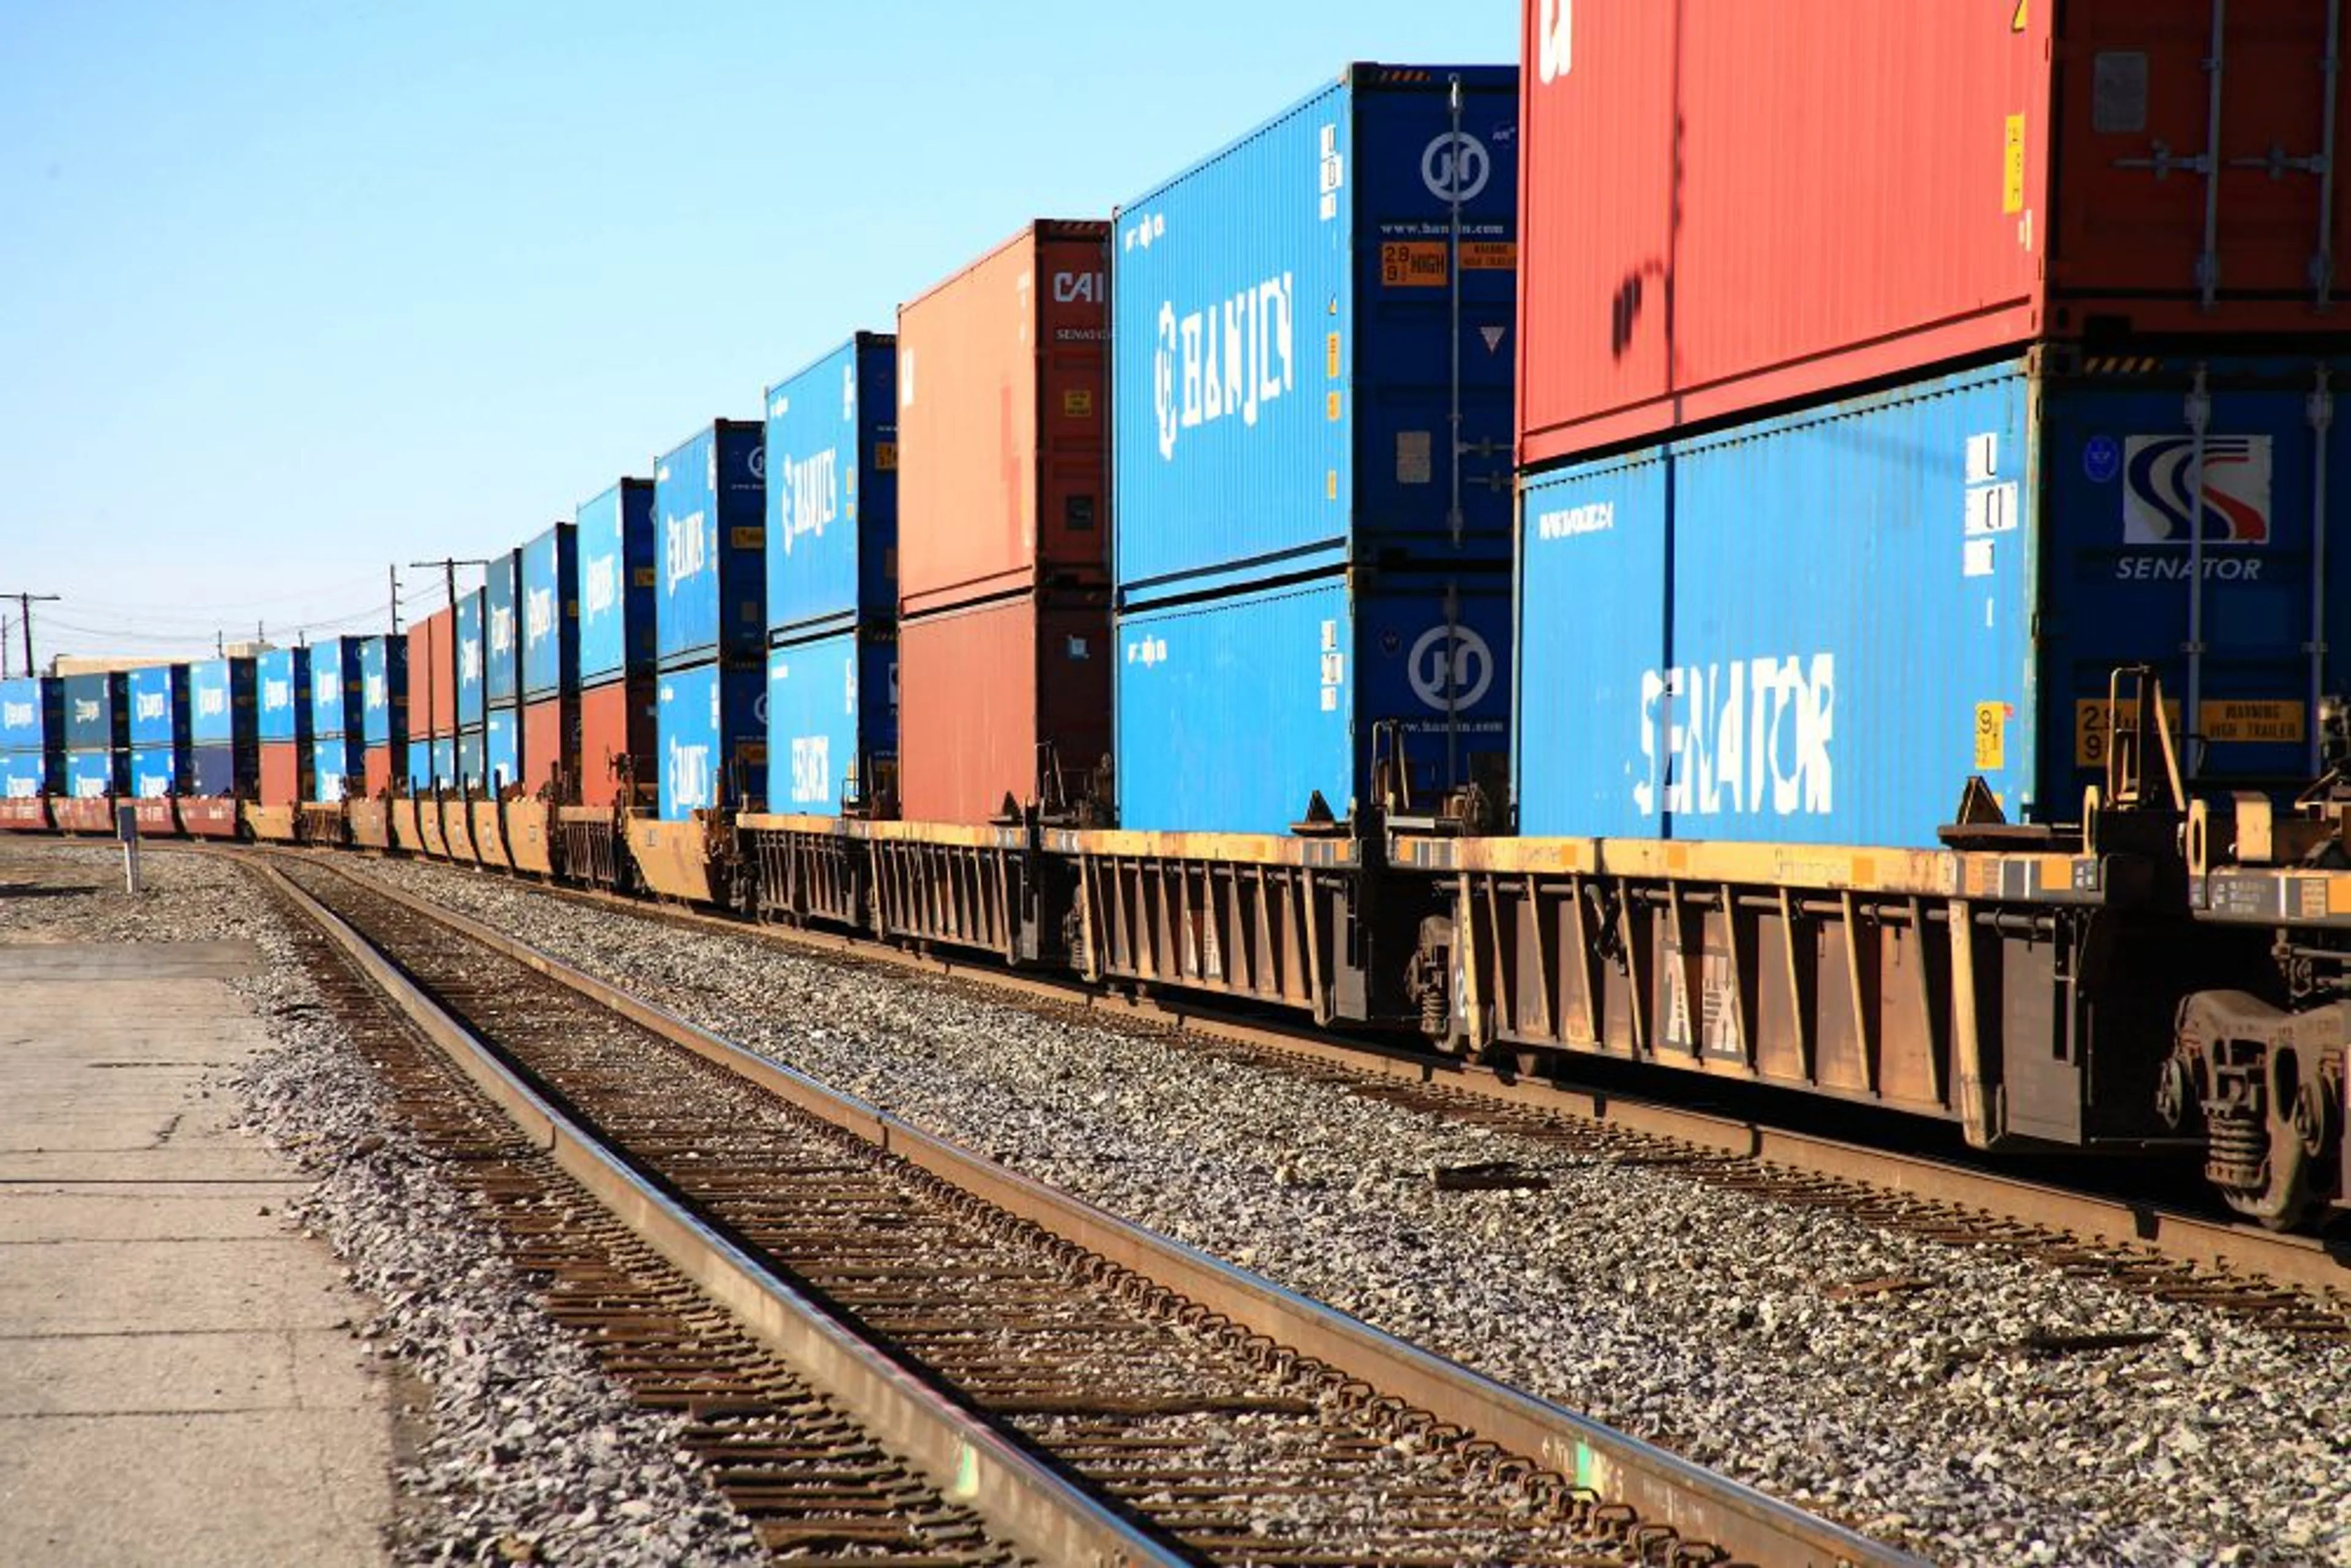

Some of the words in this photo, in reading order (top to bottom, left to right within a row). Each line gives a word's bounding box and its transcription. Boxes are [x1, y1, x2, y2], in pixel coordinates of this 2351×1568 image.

[1379, 221, 1504, 234] www.hanin.com
[1053, 272, 1104, 302] CAI
[2115, 557, 2263, 580] SENATOR
[1633, 653, 1834, 816] SENATOR
